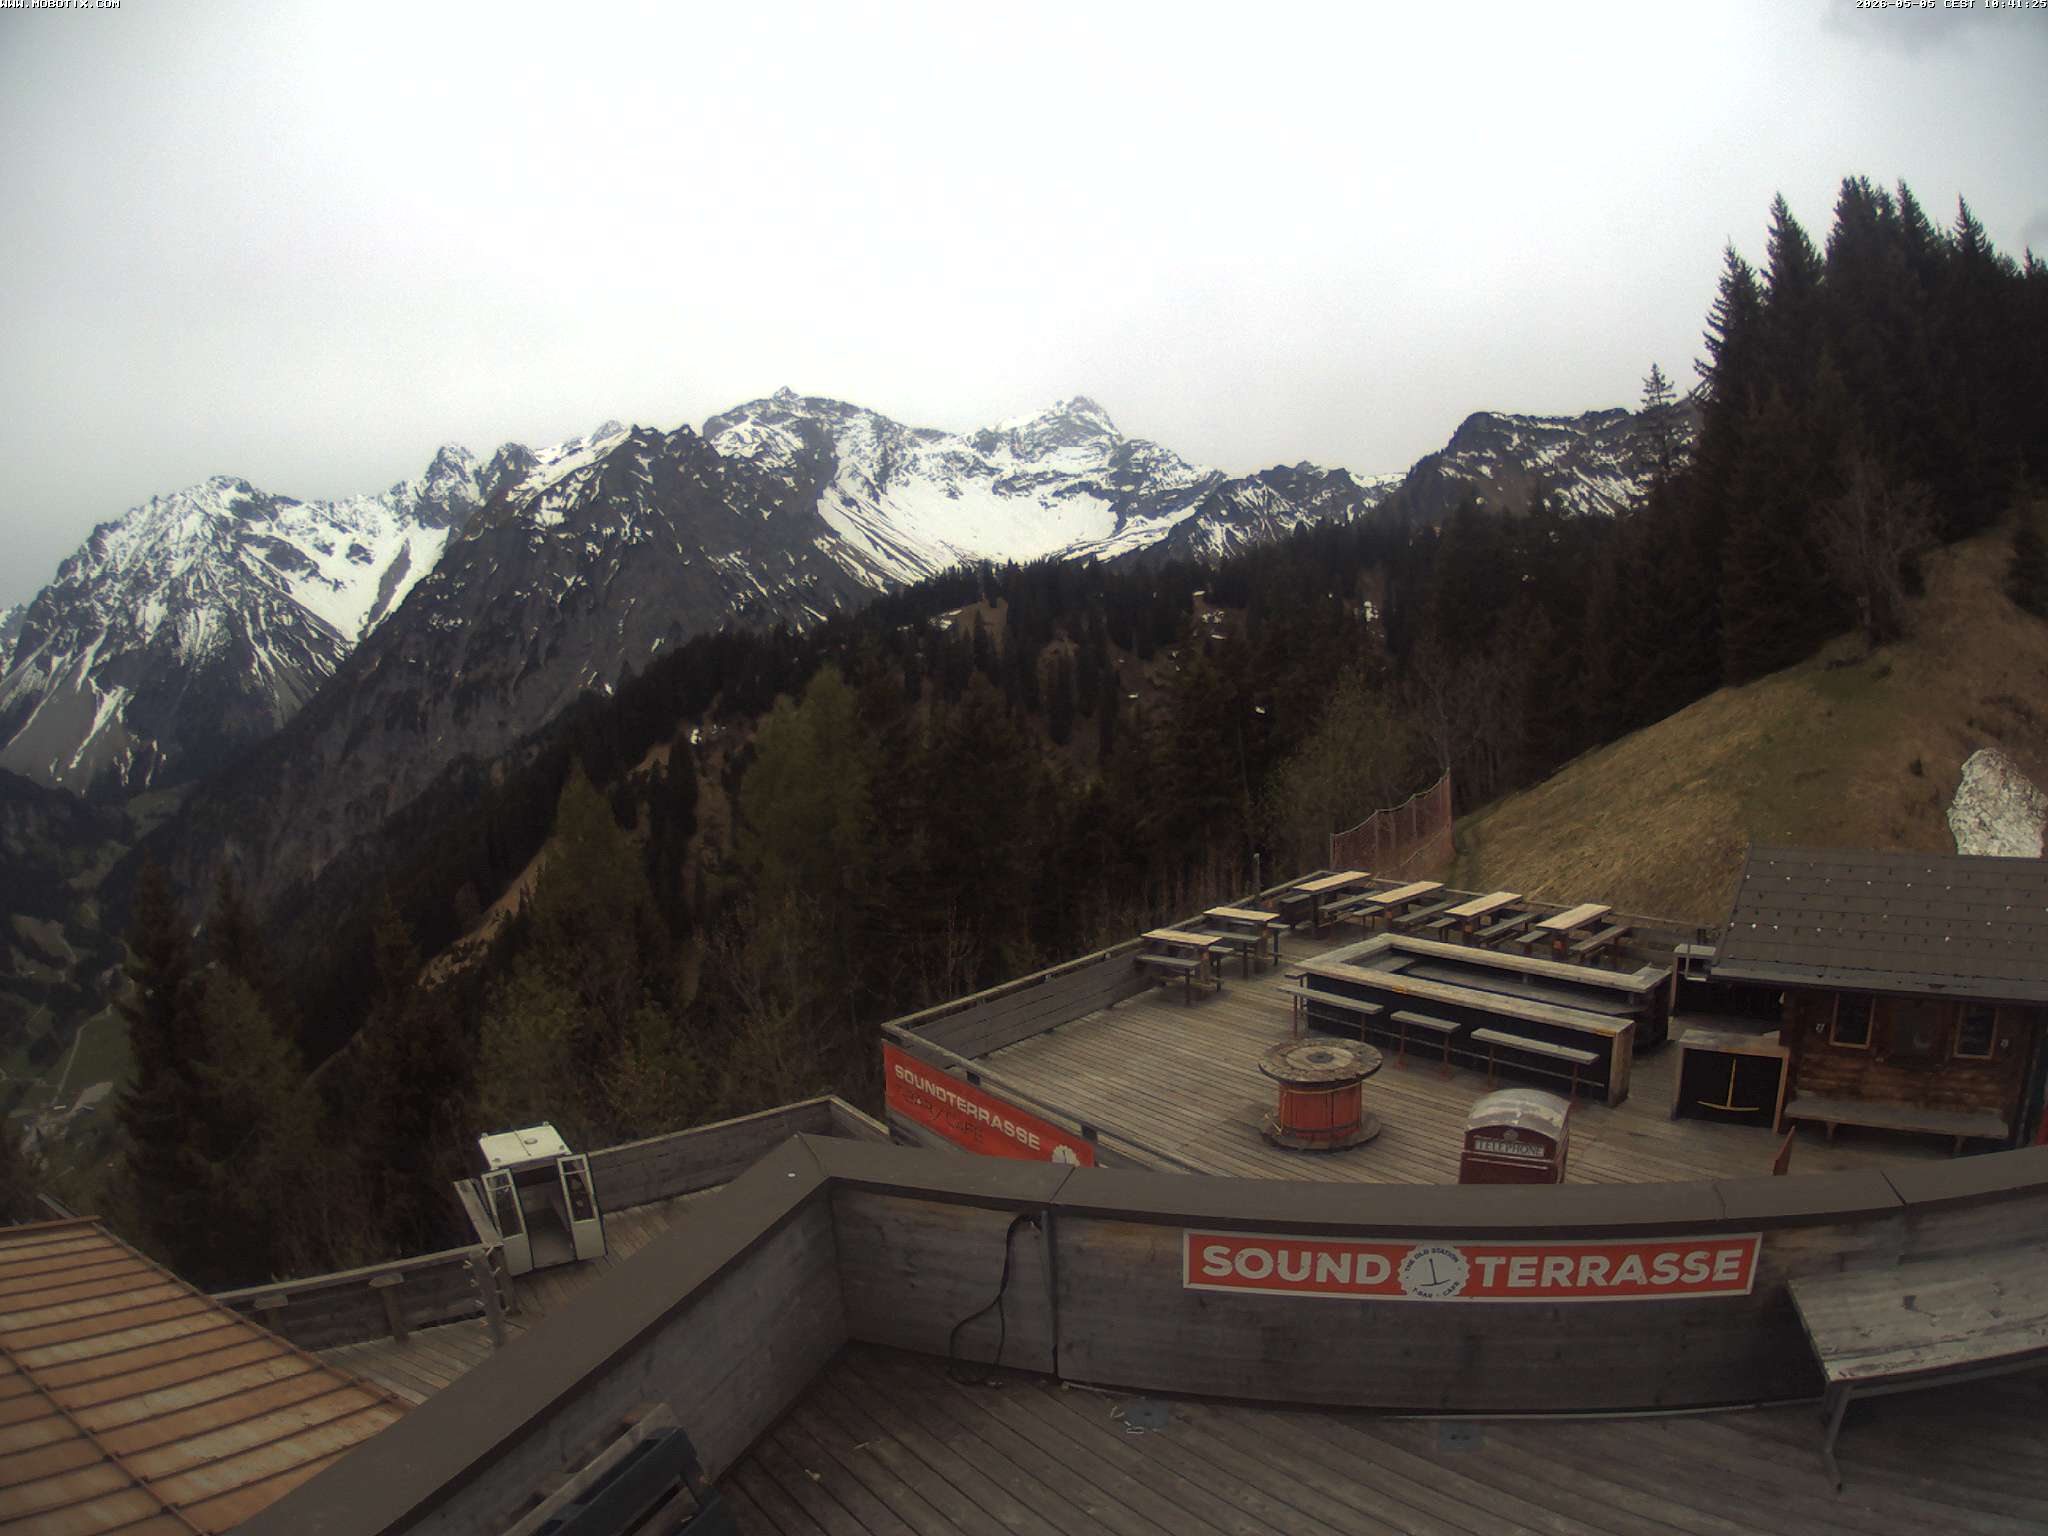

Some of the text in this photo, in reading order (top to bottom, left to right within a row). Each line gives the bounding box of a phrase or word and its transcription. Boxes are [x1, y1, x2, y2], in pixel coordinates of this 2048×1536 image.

[895, 1064, 1041, 1151] SOUNDTERRASSE
[1475, 1140, 1544, 1156] TELEPHONE
[1201, 1245, 1744, 1288] SOUND TERRASSE
[1414, 1247, 1430, 1260] OLD
[1431, 1247, 1460, 1263] STATION
